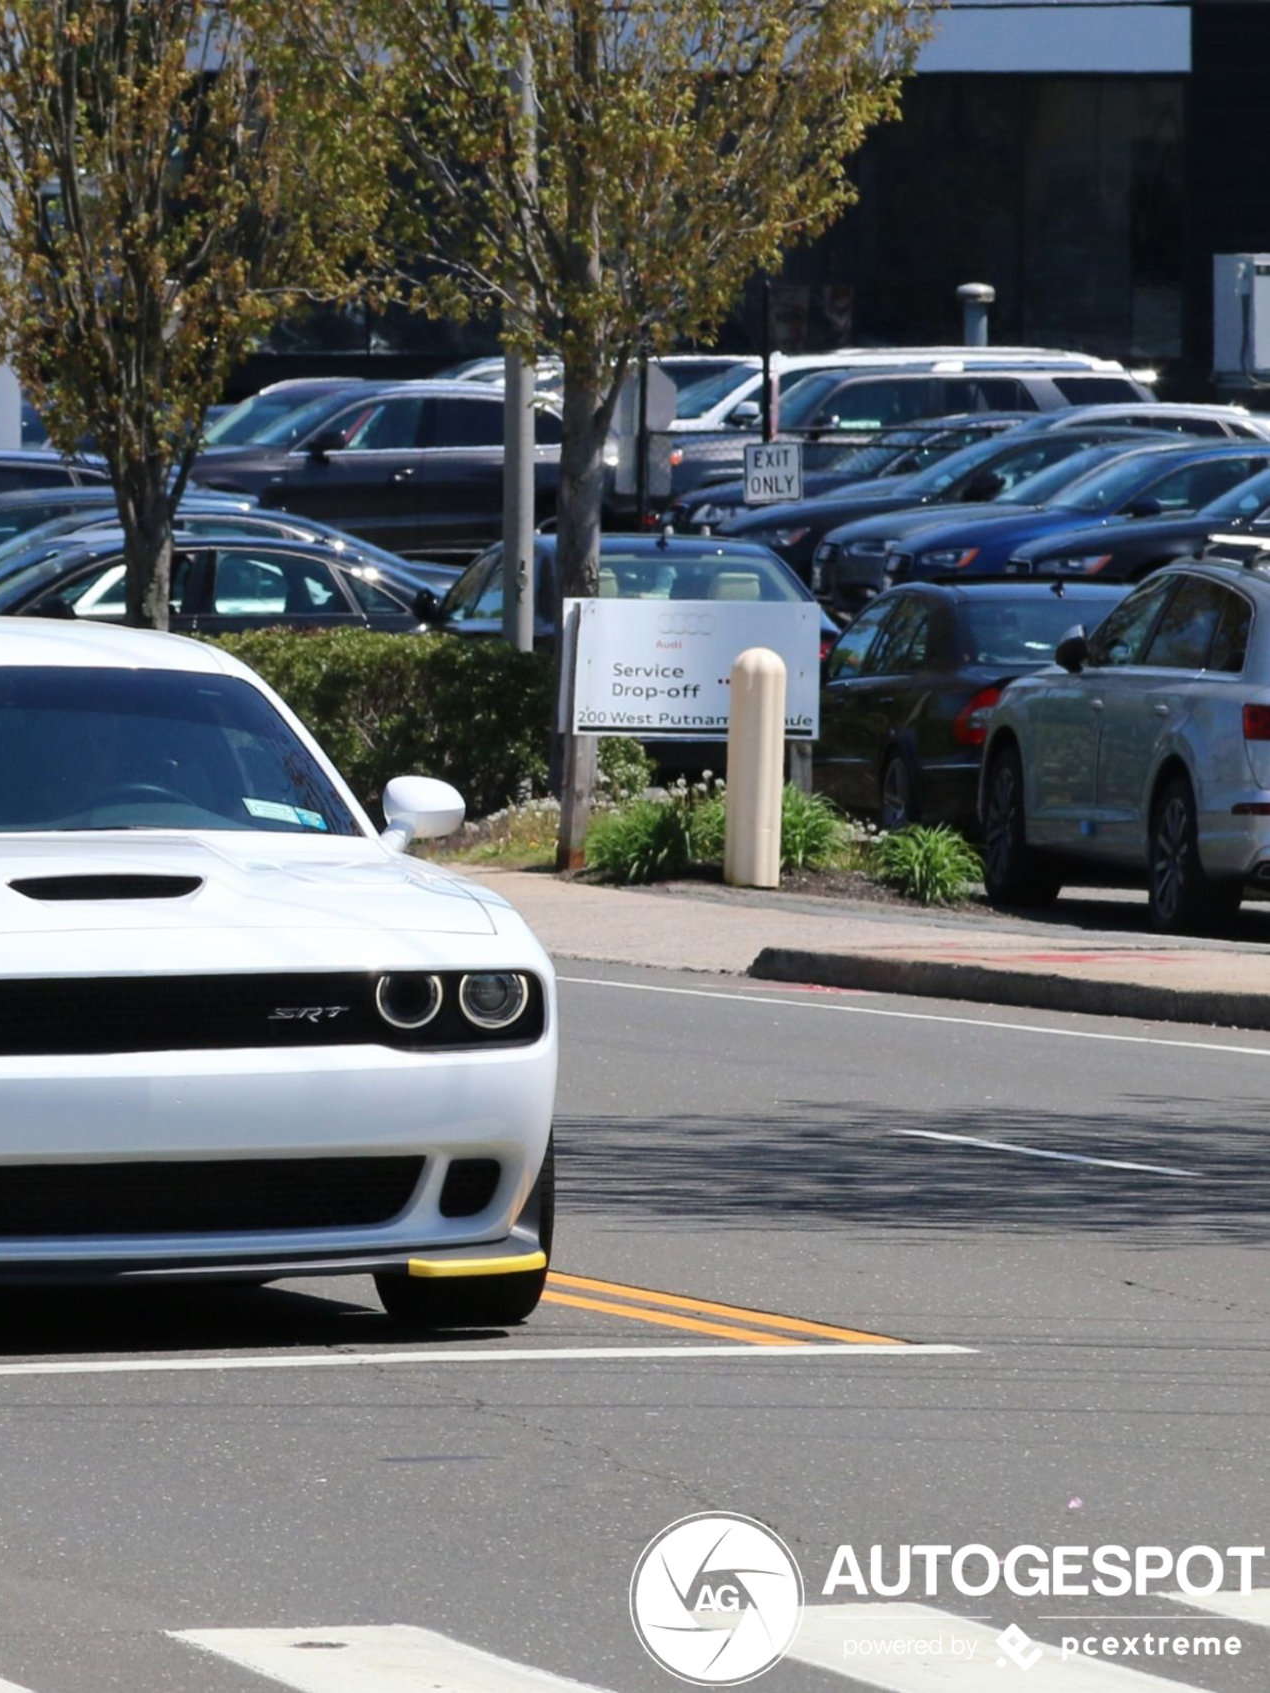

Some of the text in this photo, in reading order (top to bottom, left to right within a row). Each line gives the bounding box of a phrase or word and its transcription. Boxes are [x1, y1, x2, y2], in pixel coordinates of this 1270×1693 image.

[753, 450, 790, 469] EXIT
[750, 476, 796, 495] ONLY
[655, 639, 683, 650] Audi
[612, 662, 685, 679] Service
[611, 682, 701, 700] Drop-off
[577, 710, 607, 724] 200
[611, 711, 653, 725] West
[267, 1006, 349, 1022] SRT
